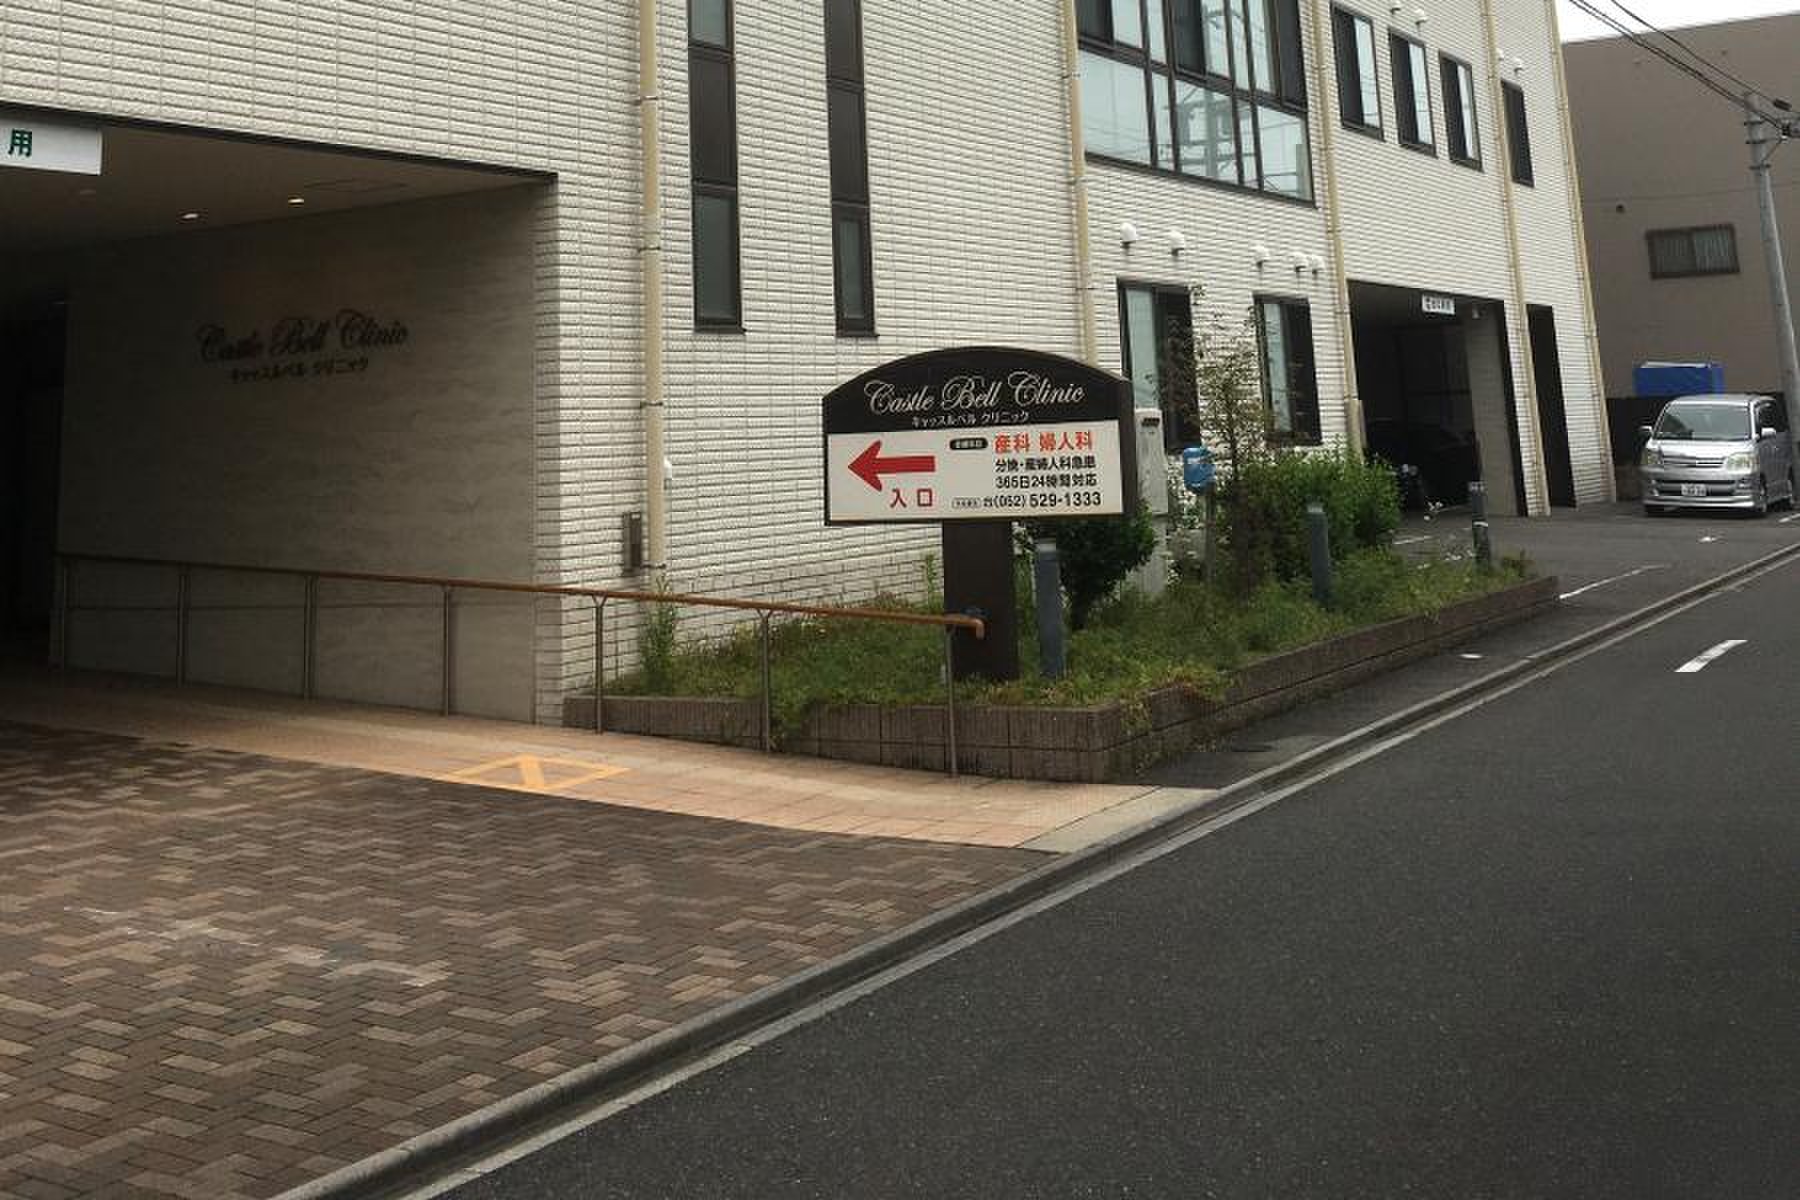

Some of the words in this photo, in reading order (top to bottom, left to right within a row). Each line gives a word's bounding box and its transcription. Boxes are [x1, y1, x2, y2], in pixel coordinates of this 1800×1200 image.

[8, 129, 32, 156] 用
[335, 309, 409, 349] Clinic
[864, 379, 932, 415] Castle
[940, 375, 1001, 411] Bell
[1007, 371, 1085, 407] Clinic
[981, 410, 1029, 425] クリニック
[995, 431, 1029, 452] 産科
[1039, 429, 1093, 451] 婦人科
[995, 473, 1097, 490] 365日24時間対応
[890, 488, 934, 509] 入口
[1029, 491, 1101, 508] 529-1333
